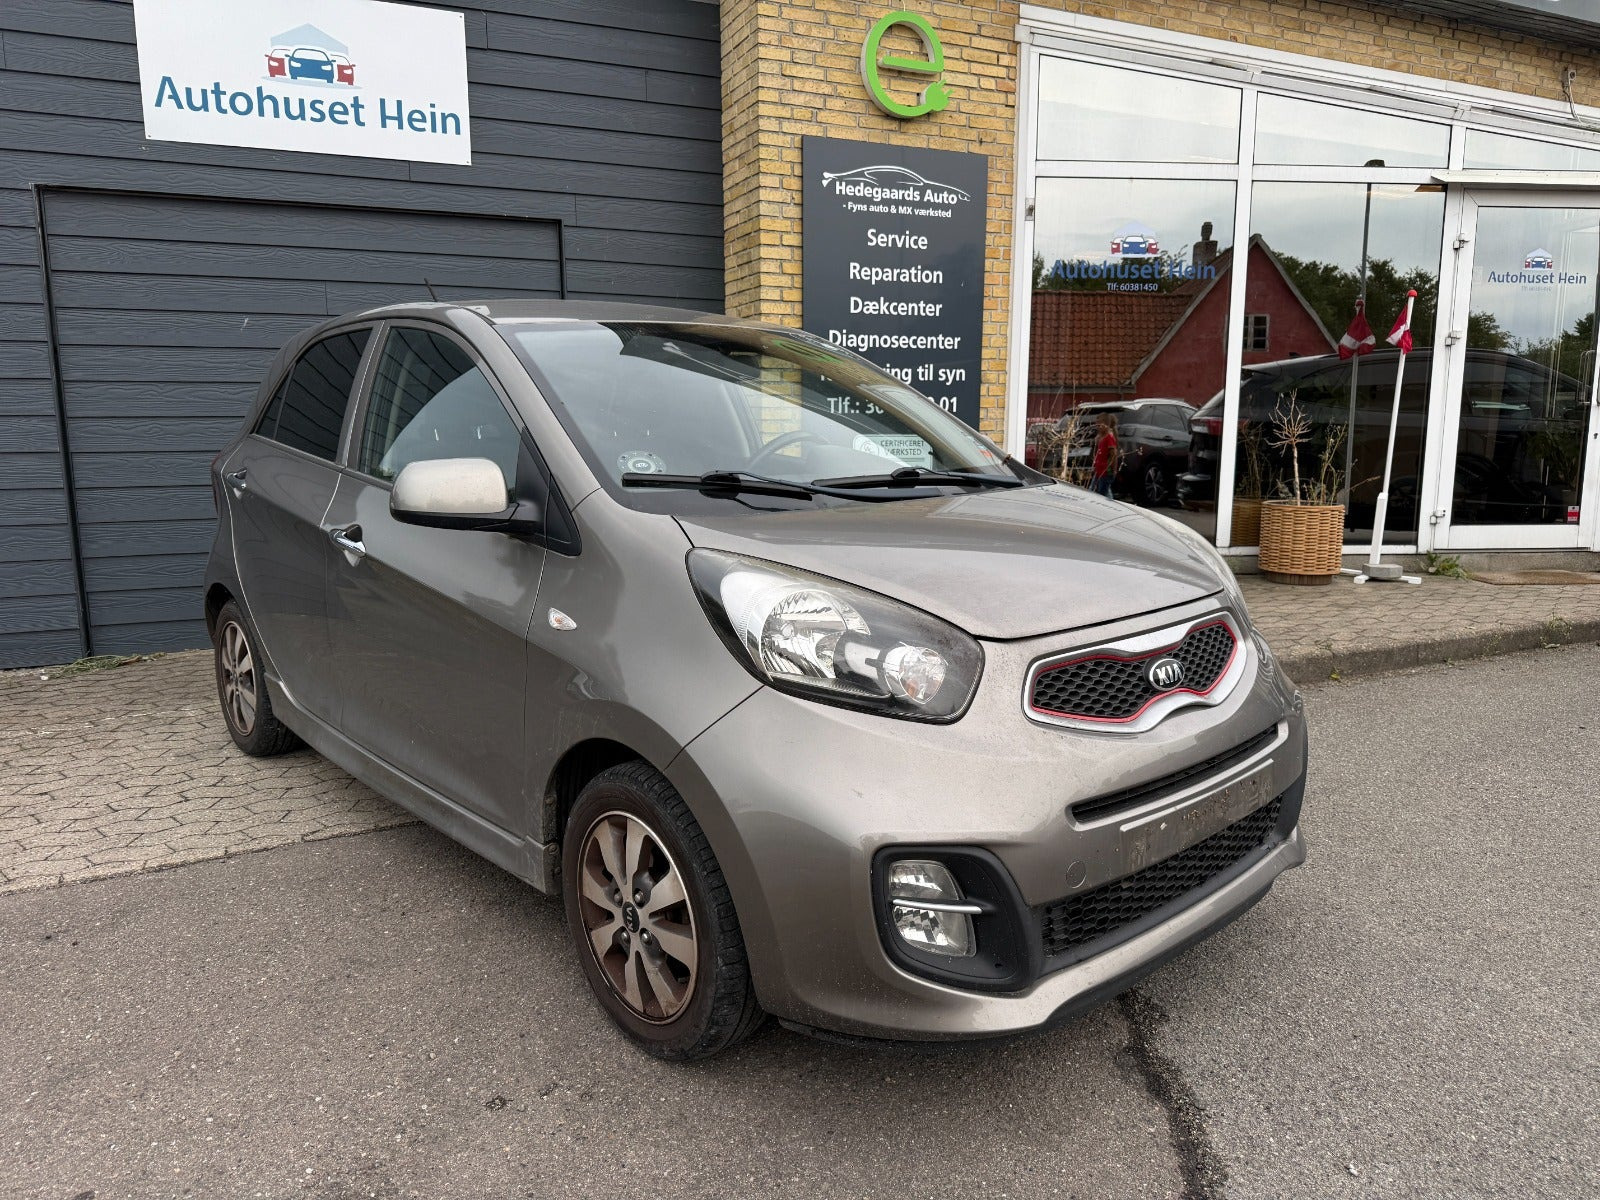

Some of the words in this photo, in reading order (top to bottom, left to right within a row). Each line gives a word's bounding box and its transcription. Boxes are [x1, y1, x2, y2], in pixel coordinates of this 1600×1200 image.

[155, 76, 365, 126] Autohuset
[379, 98, 461, 135] Hein
[835, 181, 920, 201] Hedegaards
[923, 189, 957, 204] Auto
[847, 202, 867, 212] Fyns
[869, 204, 889, 213] auto
[890, 205, 897, 214] &
[898, 205, 912, 215] MX
[914, 208, 952, 218] værksted
[867, 229, 928, 250] Service
[849, 262, 943, 285] Reparation
[1050, 260, 1161, 280] Autohuset
[1169, 261, 1216, 280] Hein
[1488, 271, 1554, 283] Autohuset
[1558, 272, 1586, 284] Hein
[1120, 283, 1158, 292] 60381450
[850, 296, 942, 317] Dækcenter
[828, 329, 960, 351] Diagnosecenter
[917, 363, 934, 381] til
[938, 368, 966, 386] syn
[827, 396, 860, 415] Tlf.:
[1155, 663, 1183, 685] KIA
